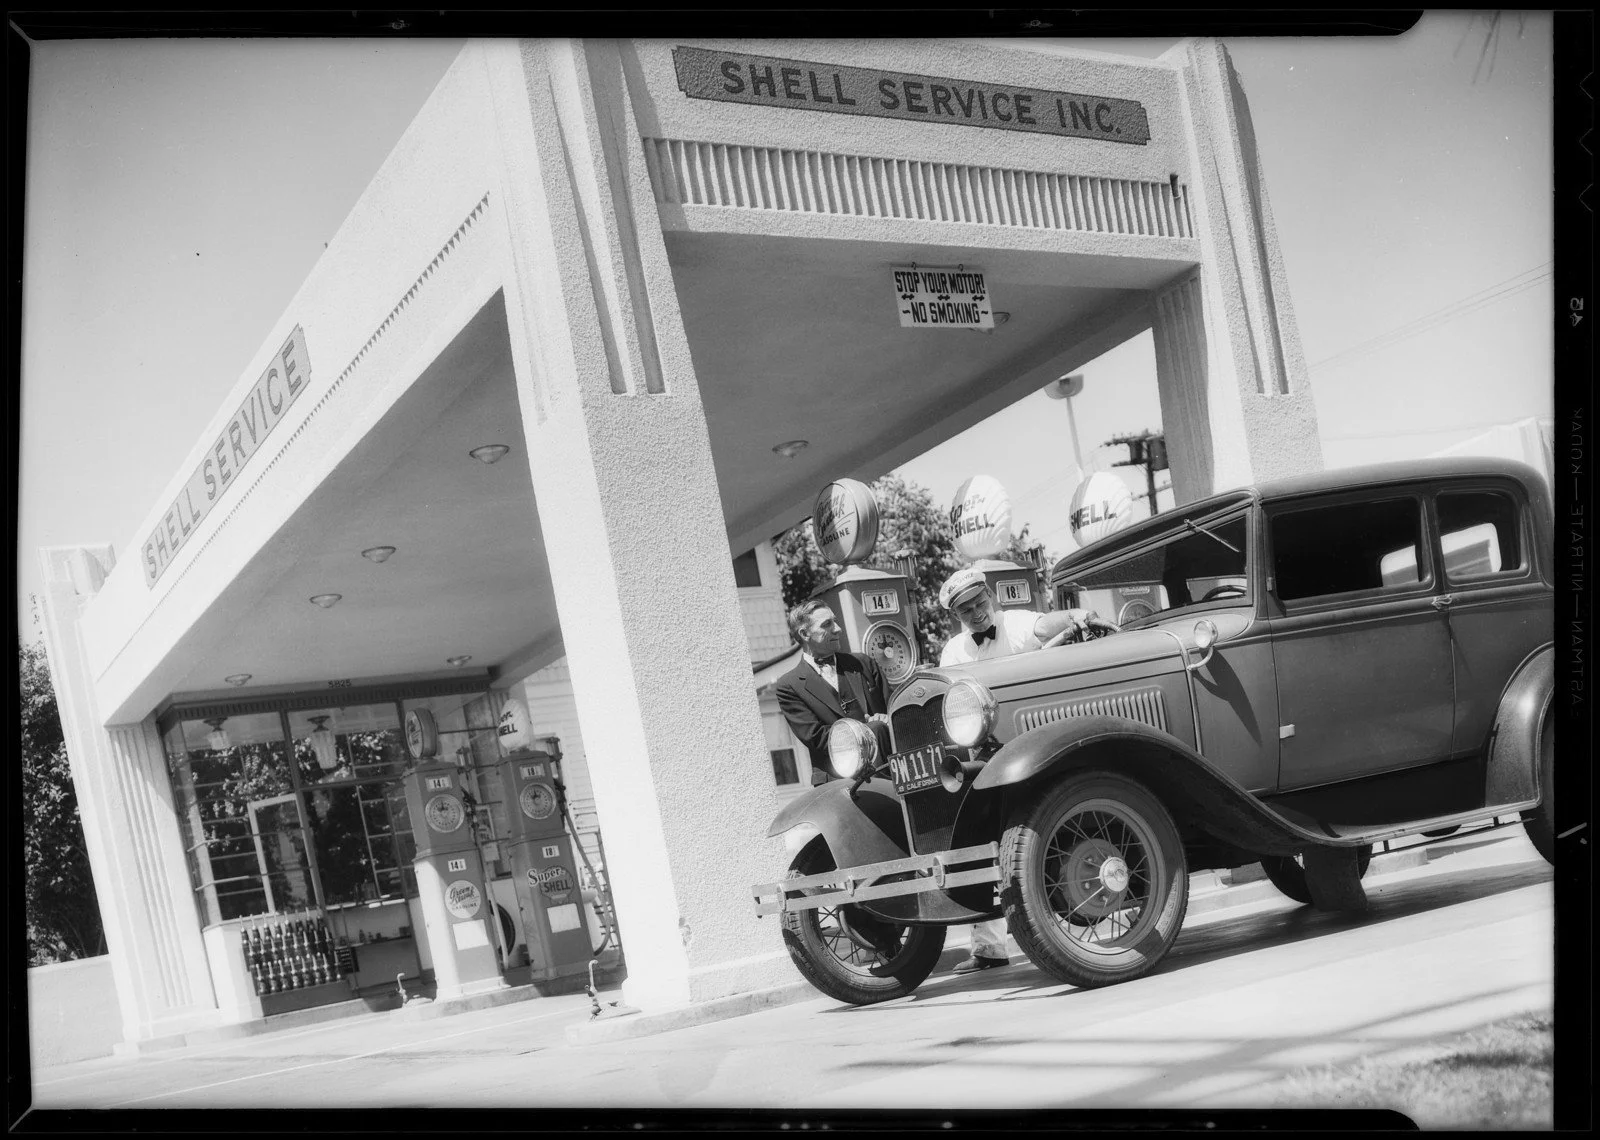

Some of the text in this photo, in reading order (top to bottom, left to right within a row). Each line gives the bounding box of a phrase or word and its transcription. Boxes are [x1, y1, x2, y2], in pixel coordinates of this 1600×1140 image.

[720, 60, 1122, 135] SHELL SERVICE INC.
[894, 271, 986, 295] STOP YOUR MOTOR!
[911, 301, 981, 324] NO SMOKING
[146, 339, 302, 580] SHELL SERVICE
[543, 879, 572, 893] SHELL
